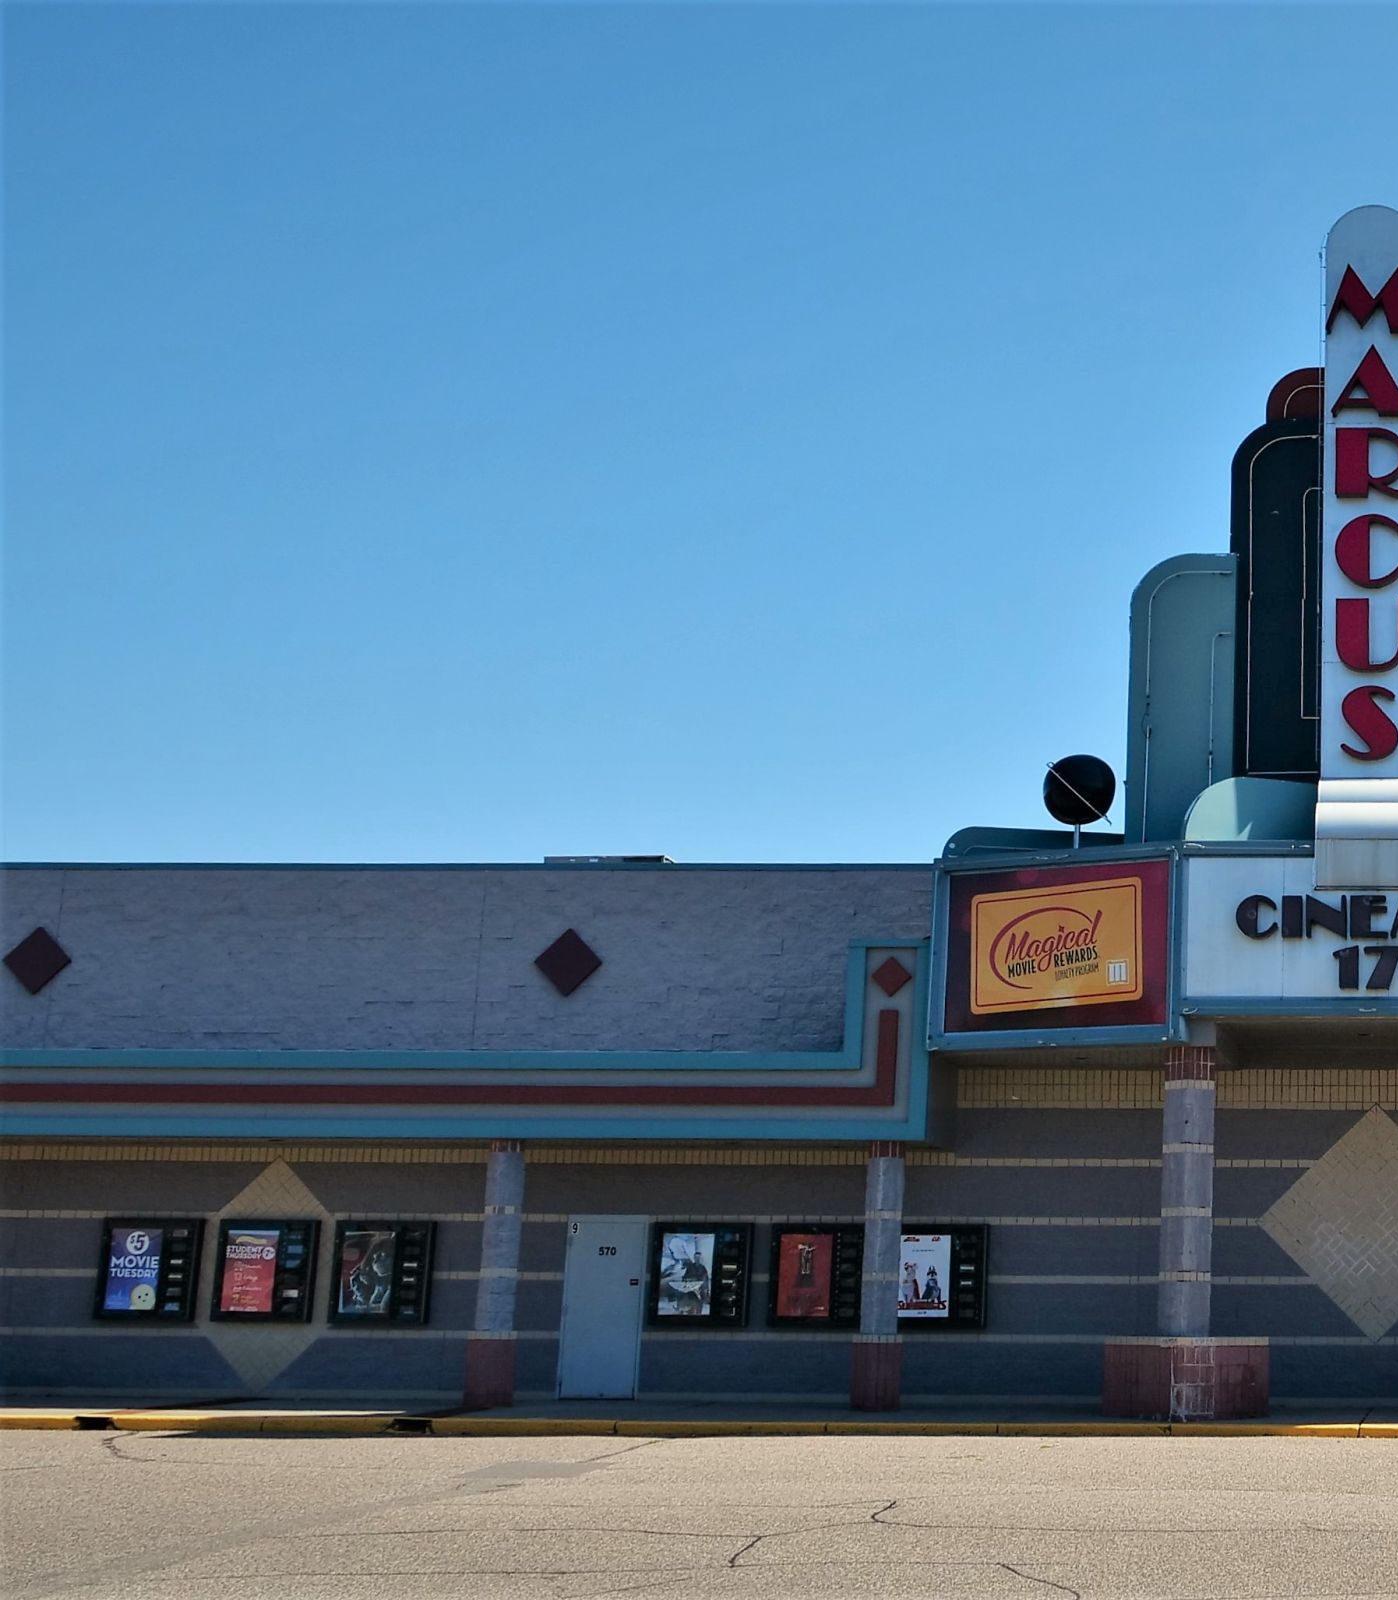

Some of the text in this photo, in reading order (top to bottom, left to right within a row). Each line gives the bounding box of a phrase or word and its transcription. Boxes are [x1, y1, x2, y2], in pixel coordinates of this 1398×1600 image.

[1004, 909, 1102, 972] Magical
[1007, 945, 1098, 979] MOVIE REWARDS
[572, 1223, 578, 1234] 9
[130, 1234, 145, 1251] $5
[598, 1246, 617, 1256] 570
[110, 1256, 160, 1268] MOVIE
[110, 1268, 158, 1278] TUESDAY
